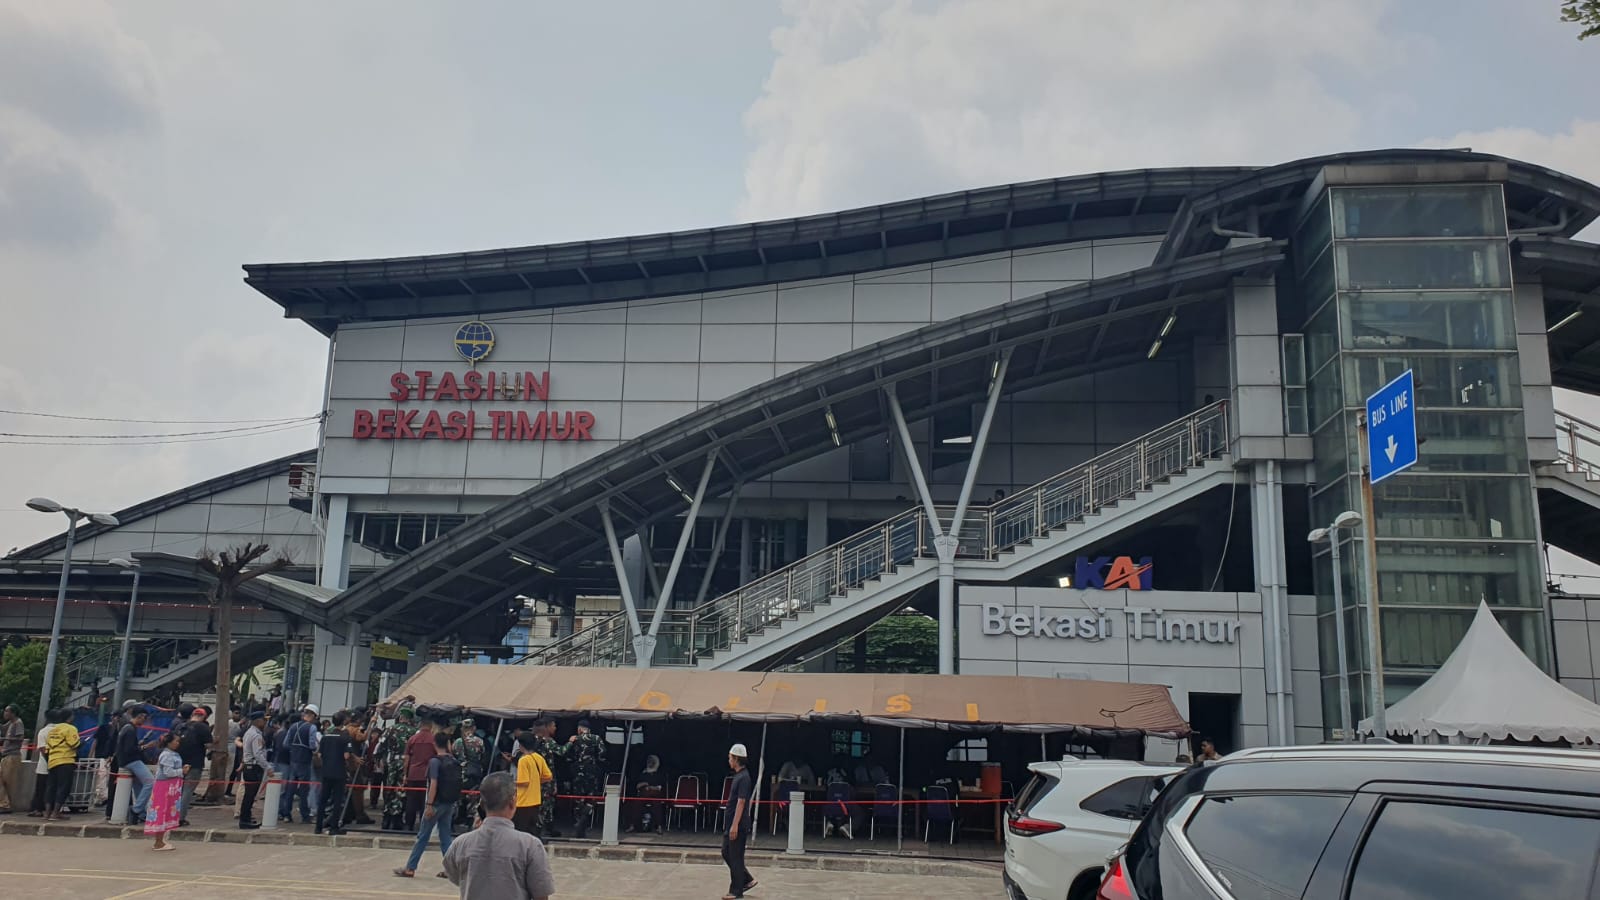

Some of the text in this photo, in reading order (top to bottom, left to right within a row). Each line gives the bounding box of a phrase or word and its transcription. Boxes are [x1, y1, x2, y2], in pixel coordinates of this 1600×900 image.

[390, 370, 550, 400] STASIUN
[353, 409, 596, 441] BEKASI TIMUR
[1372, 390, 1408, 427] BUS LINE
[1074, 556, 1152, 590] KAI
[982, 602, 1241, 643] Bekasi Timur
